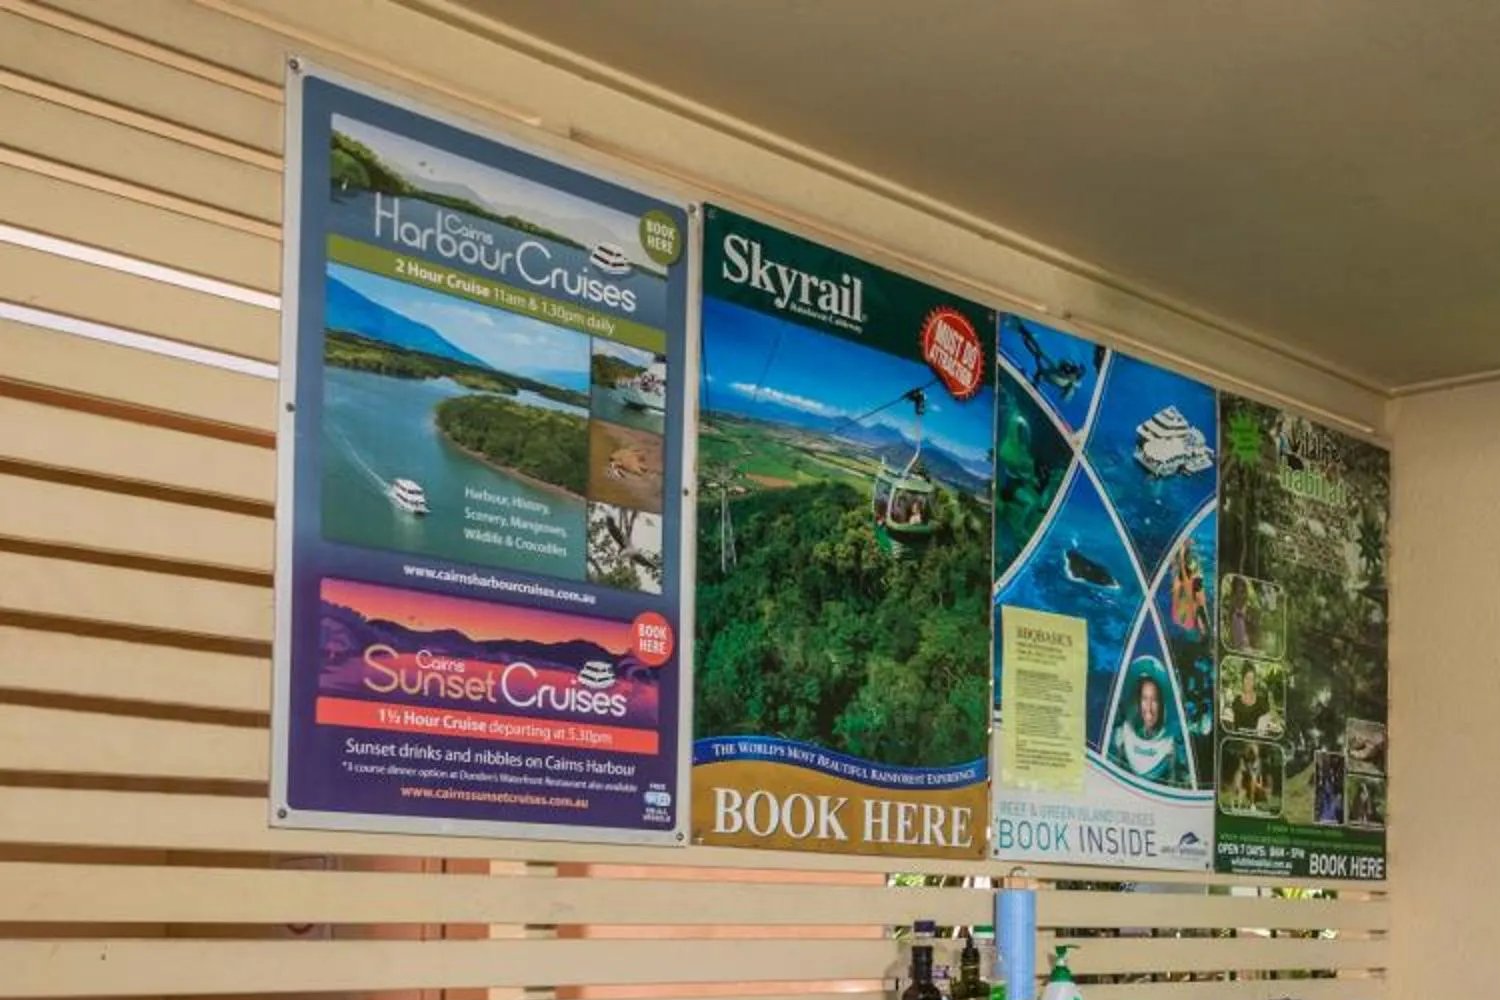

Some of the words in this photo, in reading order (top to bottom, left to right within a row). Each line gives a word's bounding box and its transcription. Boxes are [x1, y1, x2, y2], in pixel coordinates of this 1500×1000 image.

[445, 214, 493, 245] Cairns
[647, 220, 675, 241] BOOK
[647, 234, 673, 255] HERE
[375, 191, 513, 274] Harbour
[516, 241, 636, 312] Cruises
[722, 233, 864, 323] Skyrail
[395, 258, 404, 273] 2
[407, 261, 442, 283] Hour
[447, 274, 490, 297] Cruise
[494, 287, 526, 306] 11am
[528, 297, 538, 311] &
[542, 301, 585, 324] 1.30pm
[587, 315, 616, 335] daily
[464, 527, 504, 545] Wildlife
[403, 565, 597, 605] www.cairnsharbourcruises.com.au
[638, 623, 667, 641] BOOK
[639, 639, 667, 655] HERE
[416, 650, 465, 673] Cairns
[363, 644, 497, 703] Sunset
[501, 661, 628, 717] Cruises
[403, 711, 440, 726] Hour
[443, 715, 487, 731] Cruise
[488, 721, 551, 741] departing
[553, 729, 564, 740] at
[566, 728, 614, 746] 5.30pm
[345, 737, 396, 757] Sunset
[399, 743, 442, 761] drinks
[445, 747, 471, 763] and
[475, 749, 523, 767] nibbles
[525, 755, 543, 768] on
[545, 755, 584, 773] Cairns
[586, 759, 636, 776] Harbour
[712, 744, 736, 757] THE
[787, 746, 814, 764] MOST
[818, 755, 868, 778] BEAUTIFUL
[711, 787, 849, 840] BOOK
[863, 799, 973, 848] HERE
[998, 818, 1070, 851] BOOK
[1079, 825, 1158, 857] INSIDE
[1217, 842, 1238, 855] OPEN
[1309, 853, 1347, 876] BOOK
[1349, 856, 1385, 879] HERE
